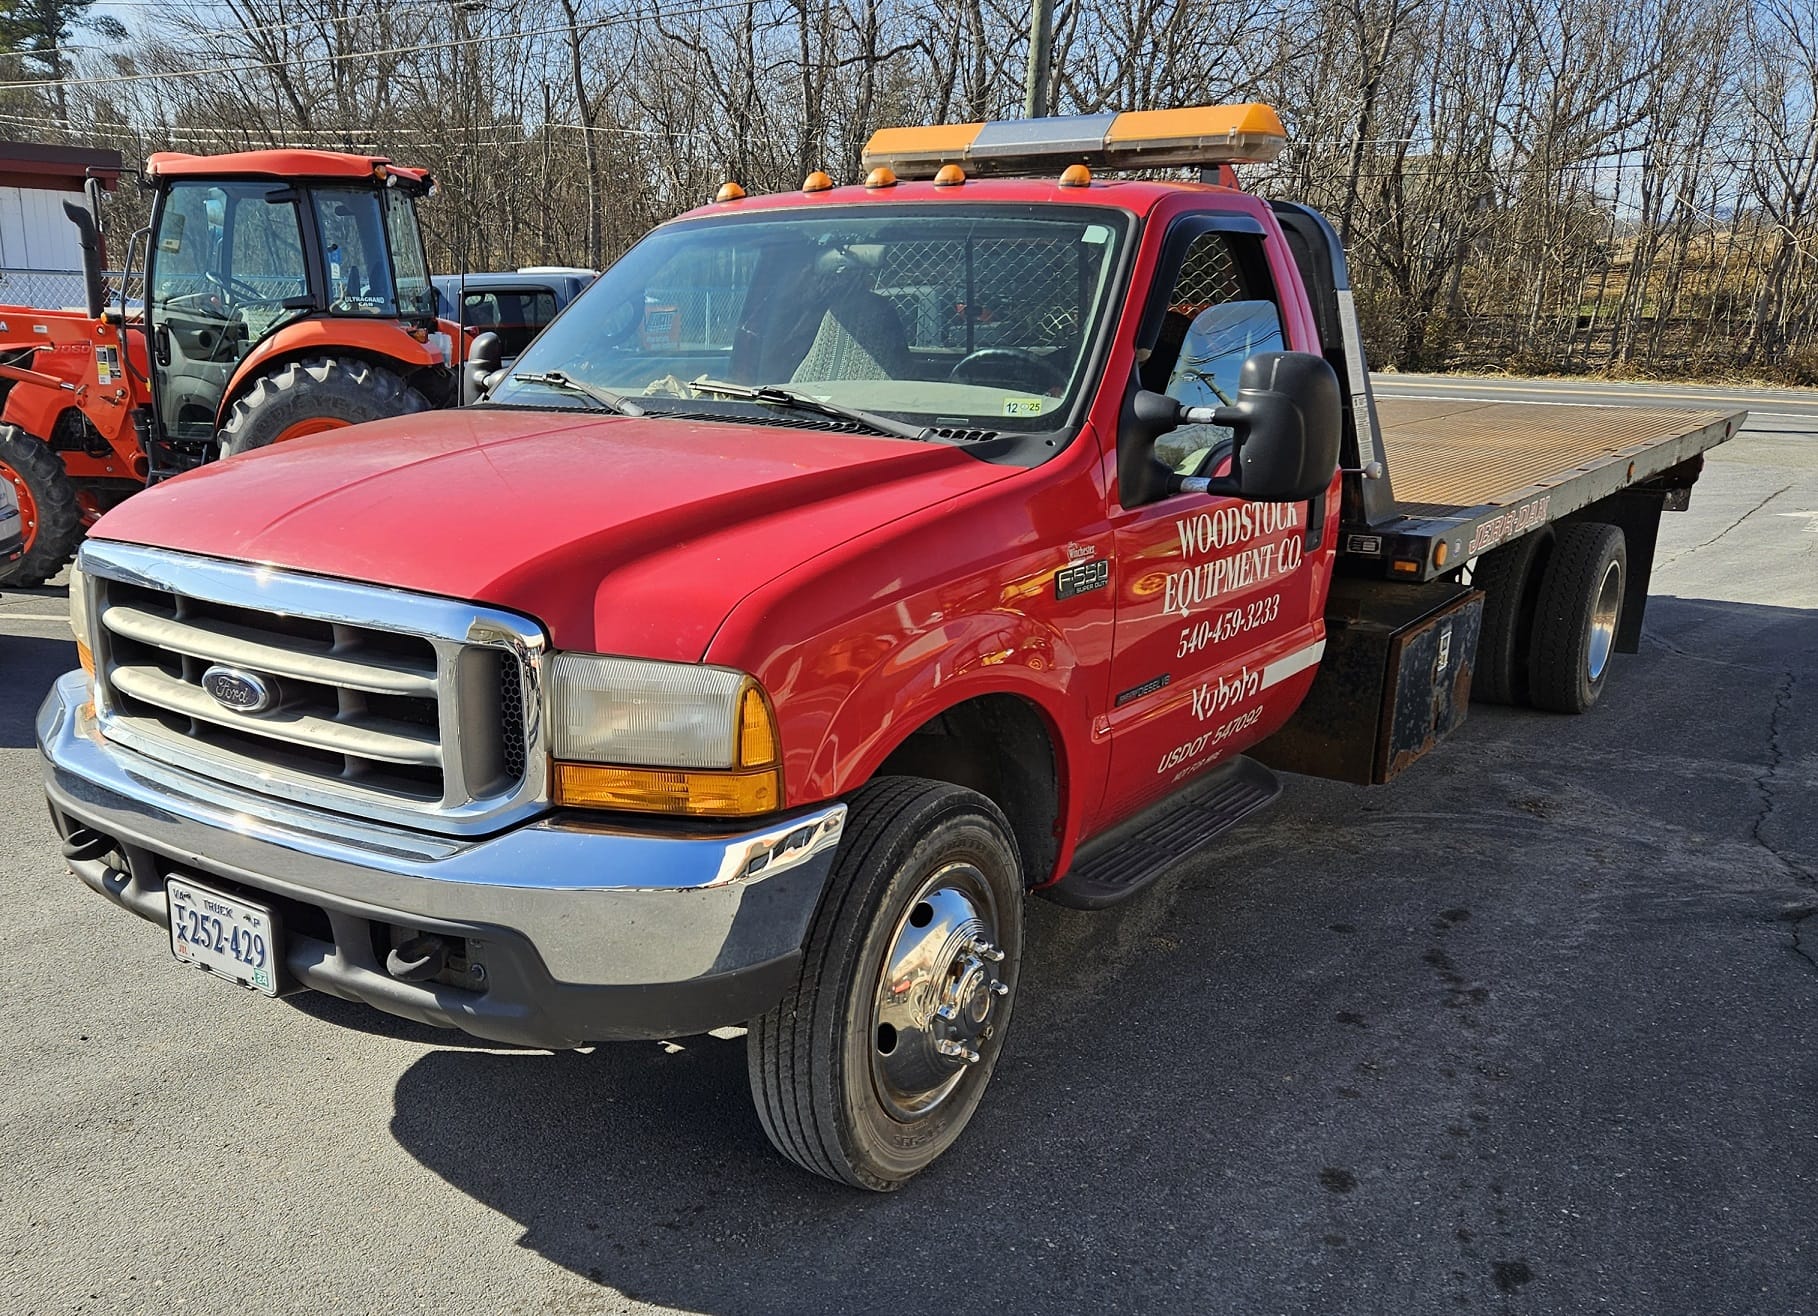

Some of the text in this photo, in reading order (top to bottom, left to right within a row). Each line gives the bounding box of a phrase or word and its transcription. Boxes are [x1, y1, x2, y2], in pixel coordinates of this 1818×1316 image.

[1006, 402, 1041, 414] 12 25
[1176, 501, 1298, 560] WOODSTOCK
[1163, 534, 1303, 618] EQUIPMENT CO.
[1176, 593, 1281, 659] 540-459-3233
[215, 676, 249, 703] Ford
[1191, 666, 1260, 722] Kubota
[1156, 704, 1264, 774] USDOT 547092
[188, 910, 266, 969] 252-429
[203, 900, 234, 920] TRUCK
